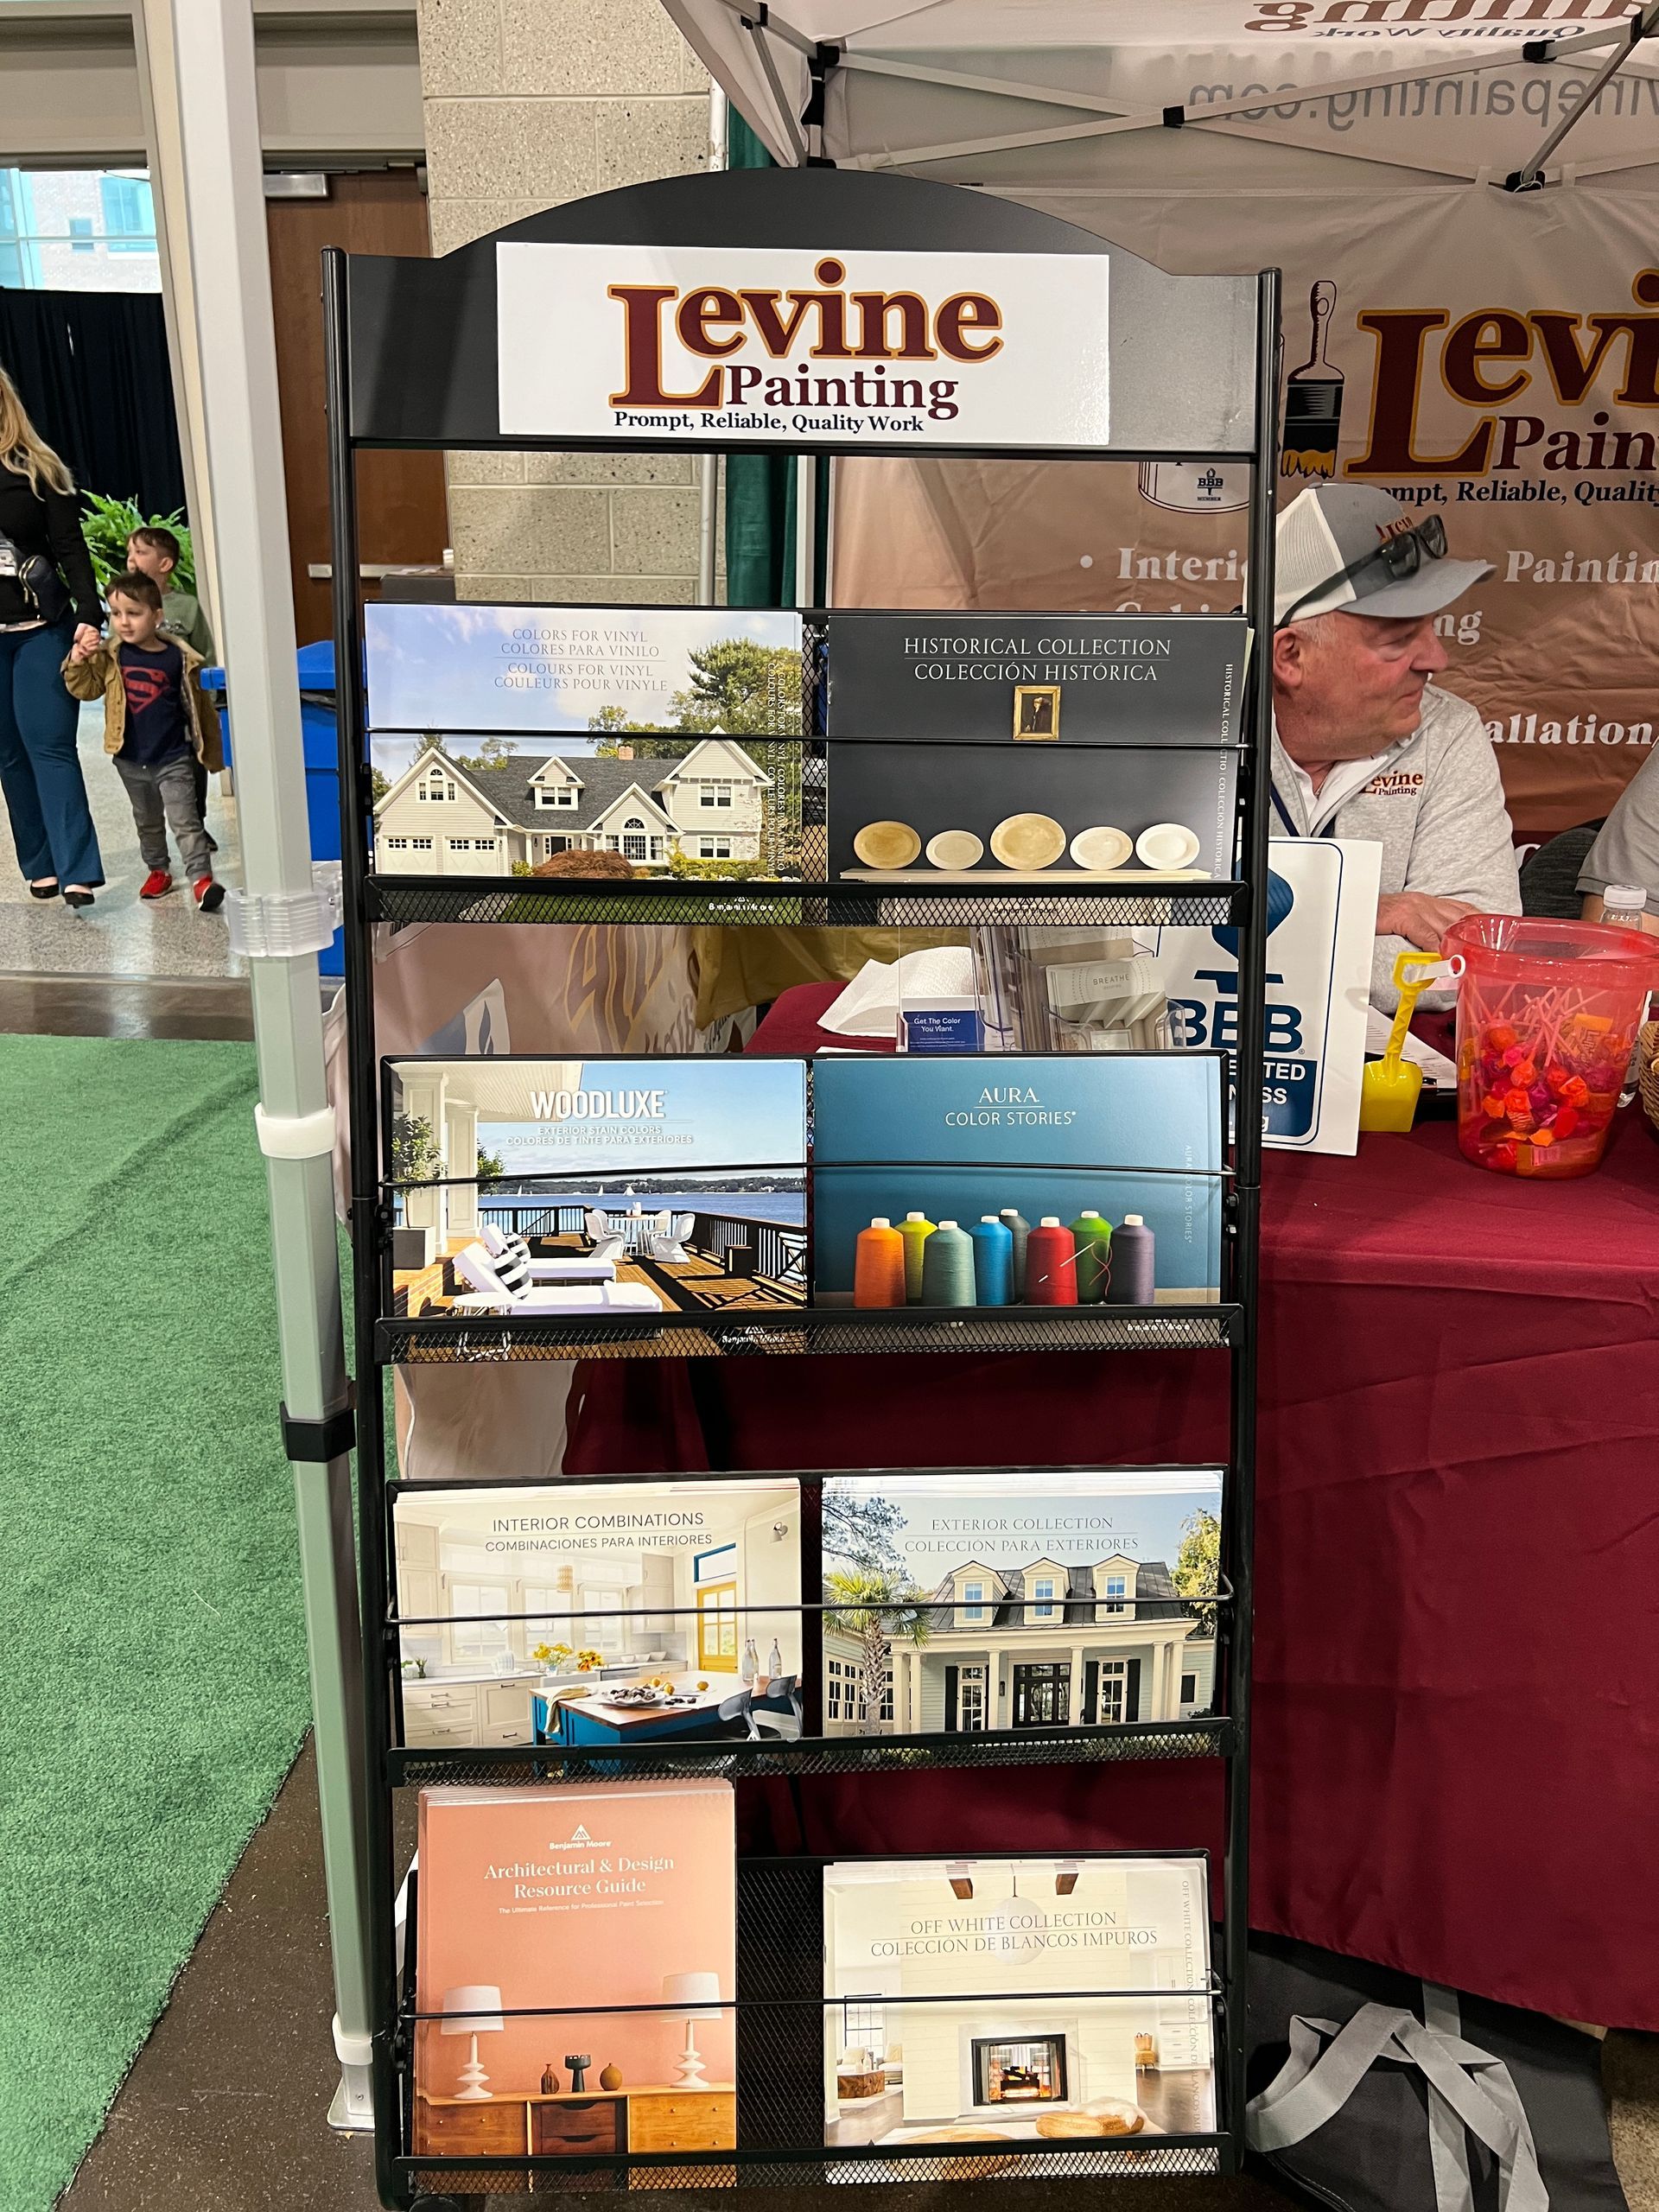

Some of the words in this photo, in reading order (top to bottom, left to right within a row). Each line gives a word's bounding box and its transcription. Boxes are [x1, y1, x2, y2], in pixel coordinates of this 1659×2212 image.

[607, 257, 1004, 410] Levine
[725, 363, 959, 420] Painting
[614, 410, 694, 431] Prompt,
[701, 412, 787, 432] Reliable,
[792, 413, 863, 434] Quality
[868, 416, 924, 431] Work
[1198, 478, 1224, 486] BBB
[1380, 483, 1448, 508] mpt,
[1455, 480, 1567, 506] Reliable,
[1116, 548, 1249, 582] Interi
[512, 629, 567, 641] COLORS
[572, 630, 599, 642] FOR
[604, 631, 648, 643] VINYL
[501, 643, 564, 655] COLORES
[569, 645, 604, 657] PARA
[609, 645, 659, 658] VINILO
[904, 638, 1031, 655] HISTORICAL
[1038, 639, 1171, 656] COLLECTION
[508, 663, 573, 675] COLOURS
[578, 664, 605, 676] FOR
[610, 664, 653, 677] VINYL
[914, 662, 1037, 681] COLECCIÓN
[1044, 663, 1158, 682] HISTÓRICA
[494, 677, 569, 690] COULEURS
[574, 678, 610, 690] POUR
[615, 679, 668, 691] VINYLE
[1222, 664, 1233, 719] HISTORICAL
[1378, 786, 1417, 796] Painting
[1093, 974, 1130, 986] BREATHE
[945, 1111, 1001, 1126] COLOR
[538, 1126, 587, 1135] EXTERIOR
[590, 1126, 618, 1135] STAIN
[621, 1126, 662, 1135] COLORS
[506, 1136, 554, 1146] COLORES
[556, 1136, 570, 1145] DE
[573, 1136, 601, 1145] TINTE
[604, 1135, 630, 1145] PARA
[633, 1135, 693, 1144] EXTERIORES
[493, 1517, 569, 1532] INTERIOR
[575, 1512, 704, 1529] COMBINATIONS
[932, 1518, 1008, 1531] EXTERIOR
[1013, 1517, 1114, 1531] COLLECTION
[485, 1538, 598, 1552] COMBINACIONES
[601, 1536, 634, 1548] PARA
[638, 1534, 712, 1547] INTERIORES
[905, 1539, 995, 1553] COLECCIÓN
[1001, 1540, 1040, 1552] PARA
[1046, 1537, 1139, 1551] EXTERIORES
[550, 1840, 584, 1851] Benjamin
[587, 1840, 611, 1848] Moore
[484, 1859, 594, 1880] Architectural
[600, 1858, 613, 1873] &
[618, 1855, 675, 1874] Design
[514, 1881, 591, 1899] Resource
[596, 1878, 646, 1894] Guide
[911, 1919, 943, 1935] OFF
[948, 1916, 1005, 1933] WHITE
[1009, 1911, 1116, 1929] COLLECTION
[871, 1936, 969, 1958] COLECCIÓN
[975, 1936, 996, 1952] DE
[1001, 1932, 1078, 1950] BLANCOS
[1083, 1929, 1158, 1947] IMPUROS
